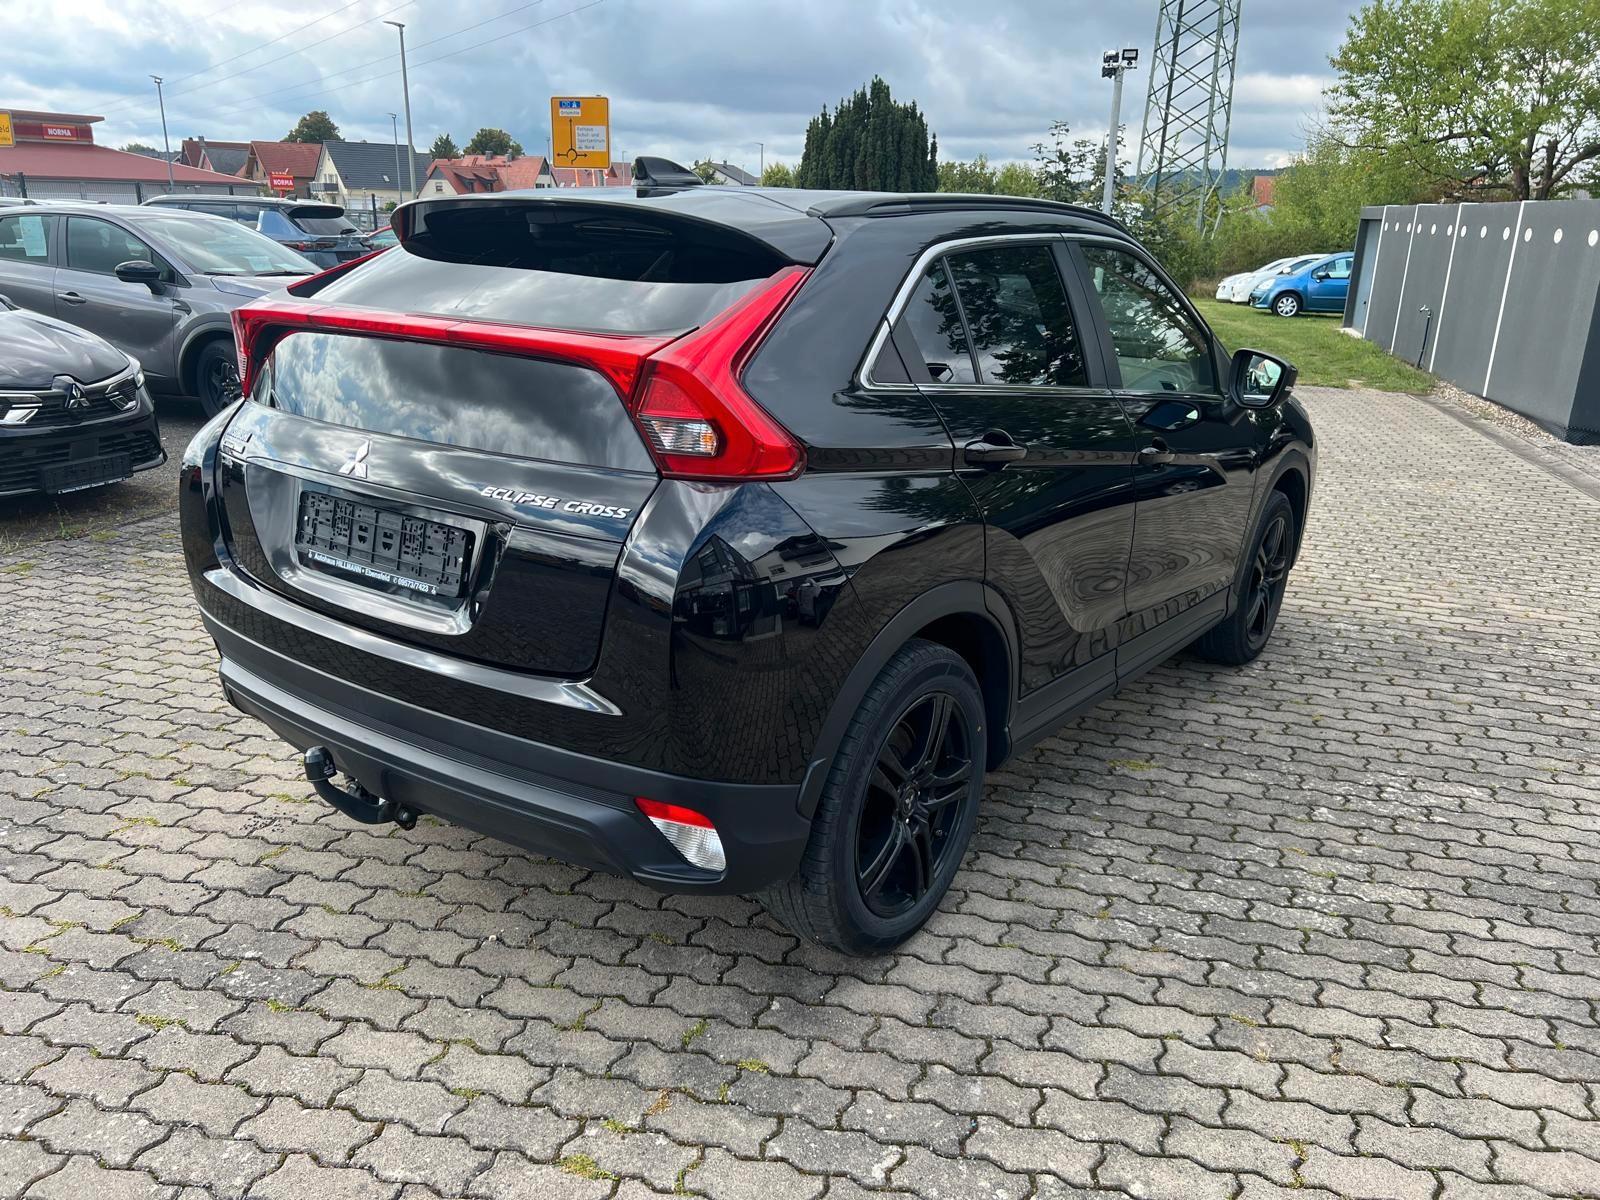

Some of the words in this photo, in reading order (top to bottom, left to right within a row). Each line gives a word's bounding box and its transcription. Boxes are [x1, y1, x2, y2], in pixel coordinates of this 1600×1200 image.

[47, 128, 72, 136] NORMA
[480, 486, 560, 510] ECLIPSE
[563, 500, 632, 520] CROSS
[313, 552, 336, 566] Autohaus
